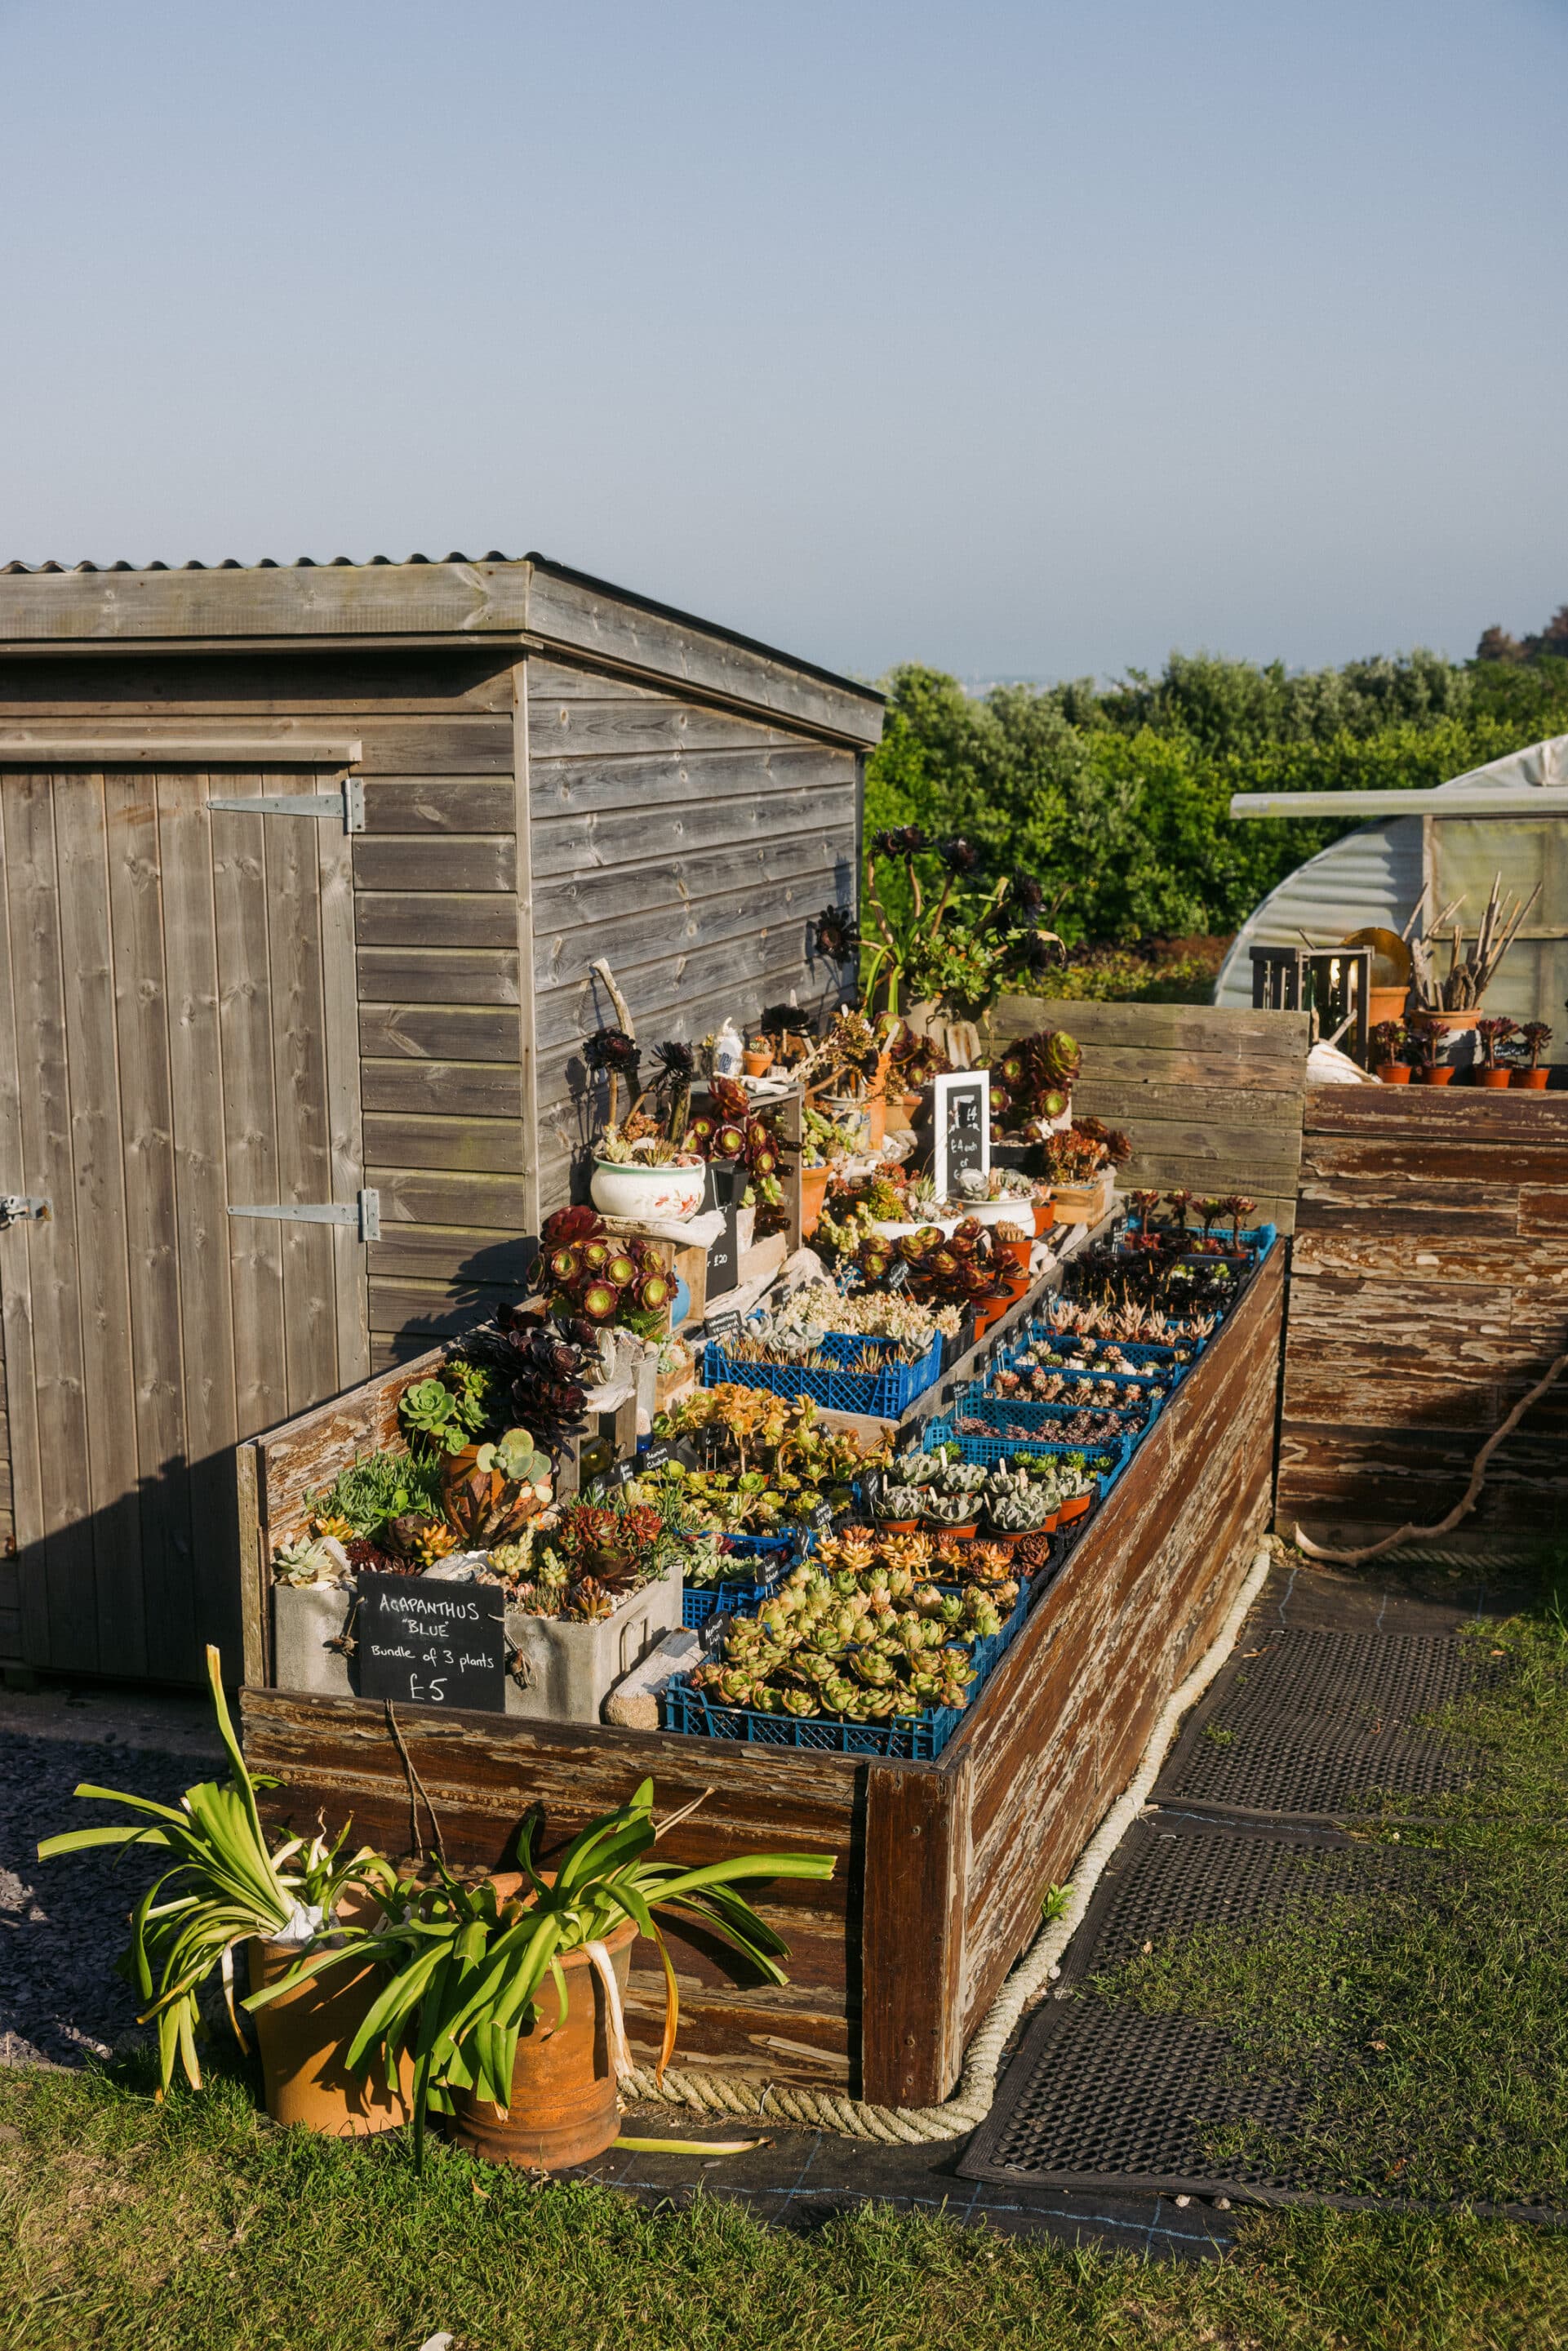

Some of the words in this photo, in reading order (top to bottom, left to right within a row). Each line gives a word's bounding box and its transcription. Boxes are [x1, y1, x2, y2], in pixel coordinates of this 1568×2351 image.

[713, 1254, 728, 1267] £20
[379, 1593, 480, 1620] AGAPANTHUS
[371, 1645, 416, 1659] Bundle
[422, 1647, 438, 1668] of
[442, 1649, 455, 1664] 3
[459, 1652, 495, 1673] plants
[409, 1672, 449, 1701] £5
